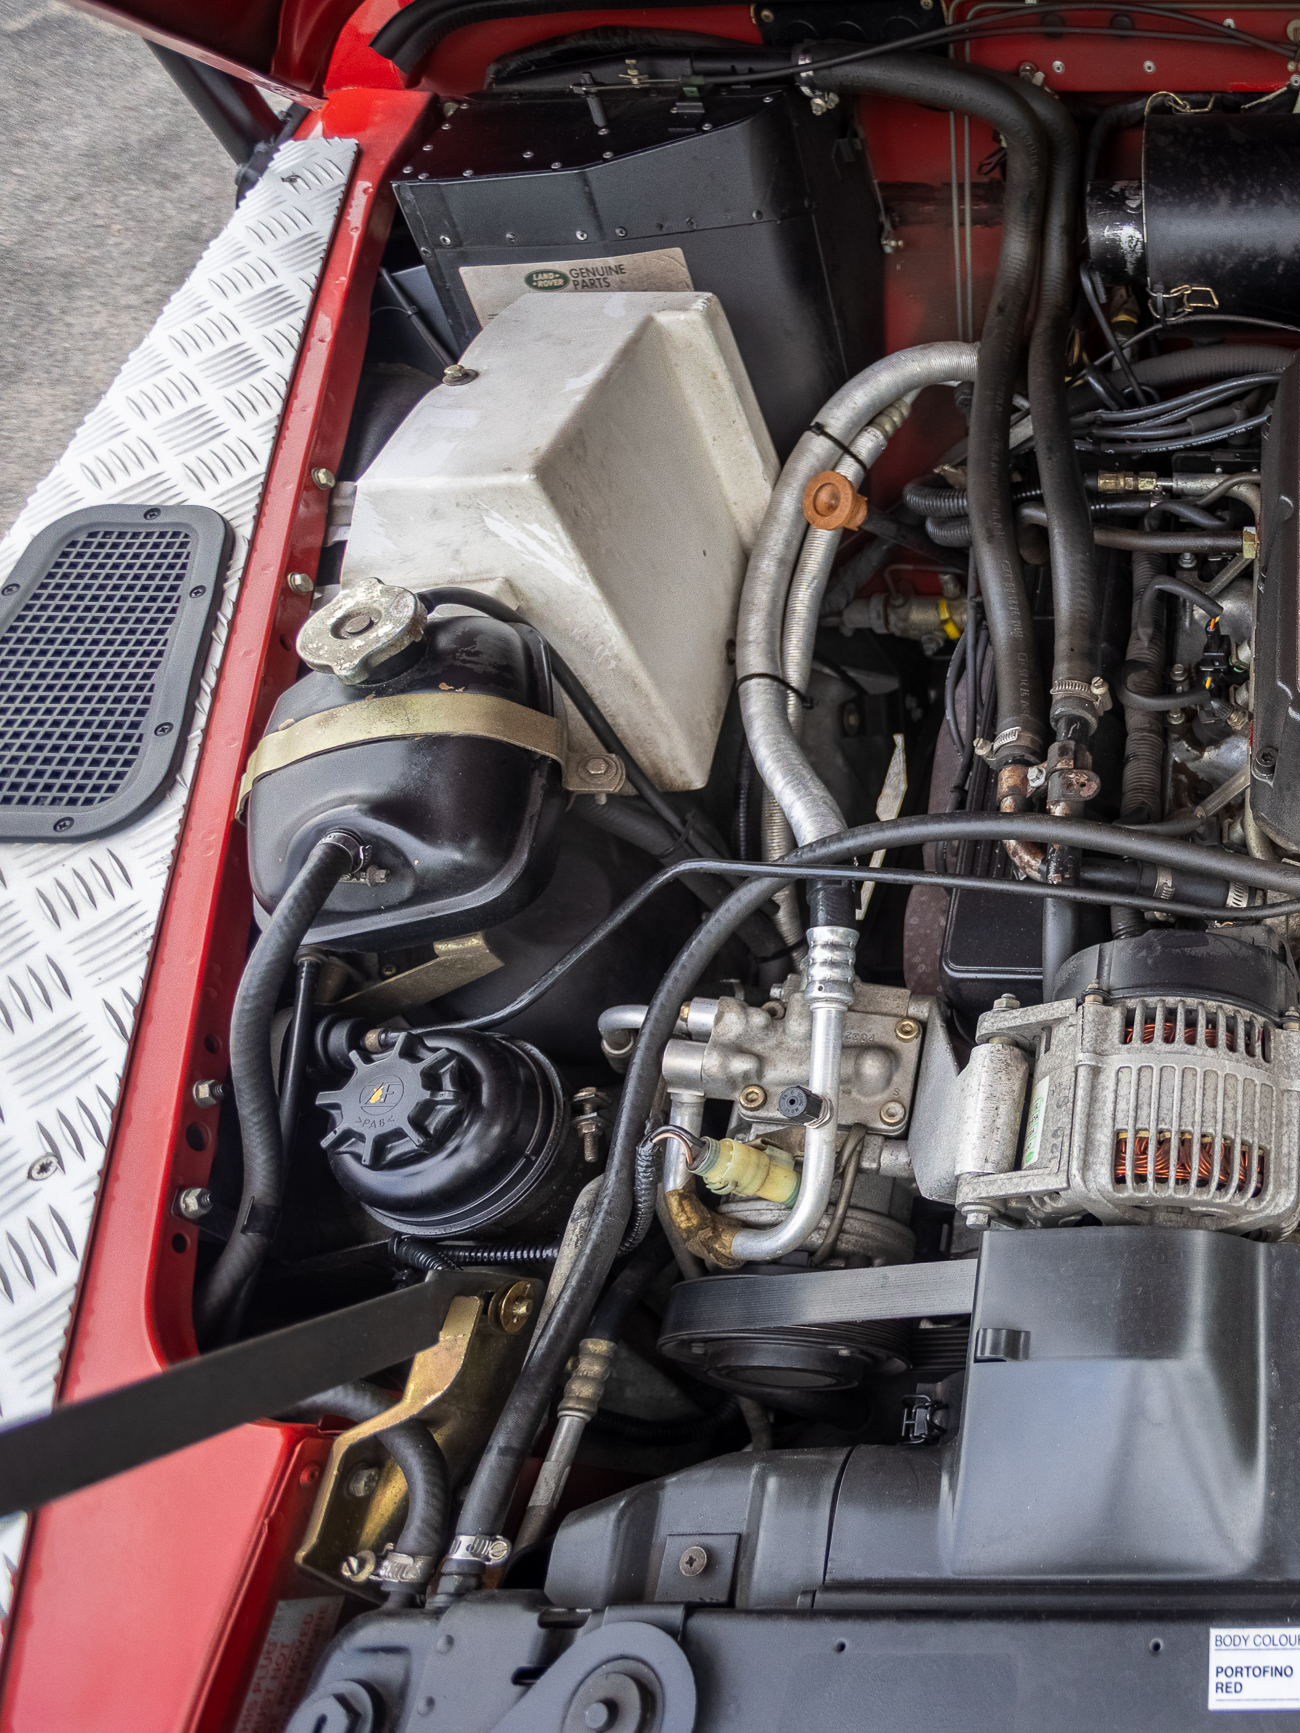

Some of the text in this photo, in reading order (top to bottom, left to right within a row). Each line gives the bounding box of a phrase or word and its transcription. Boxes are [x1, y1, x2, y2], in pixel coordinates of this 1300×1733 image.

[532, 264, 626, 281] LAND GENUINE
[537, 277, 611, 290] ROVER PARTS
[1214, 1634, 1250, 1647] BODY
[269, 1642, 290, 1682] NOT
[275, 1612, 314, 1706] REMOVED
[252, 1639, 278, 1695] PLUG
[1216, 1666, 1294, 1678] PORTOFINO
[1216, 1682, 1243, 1694] RED
